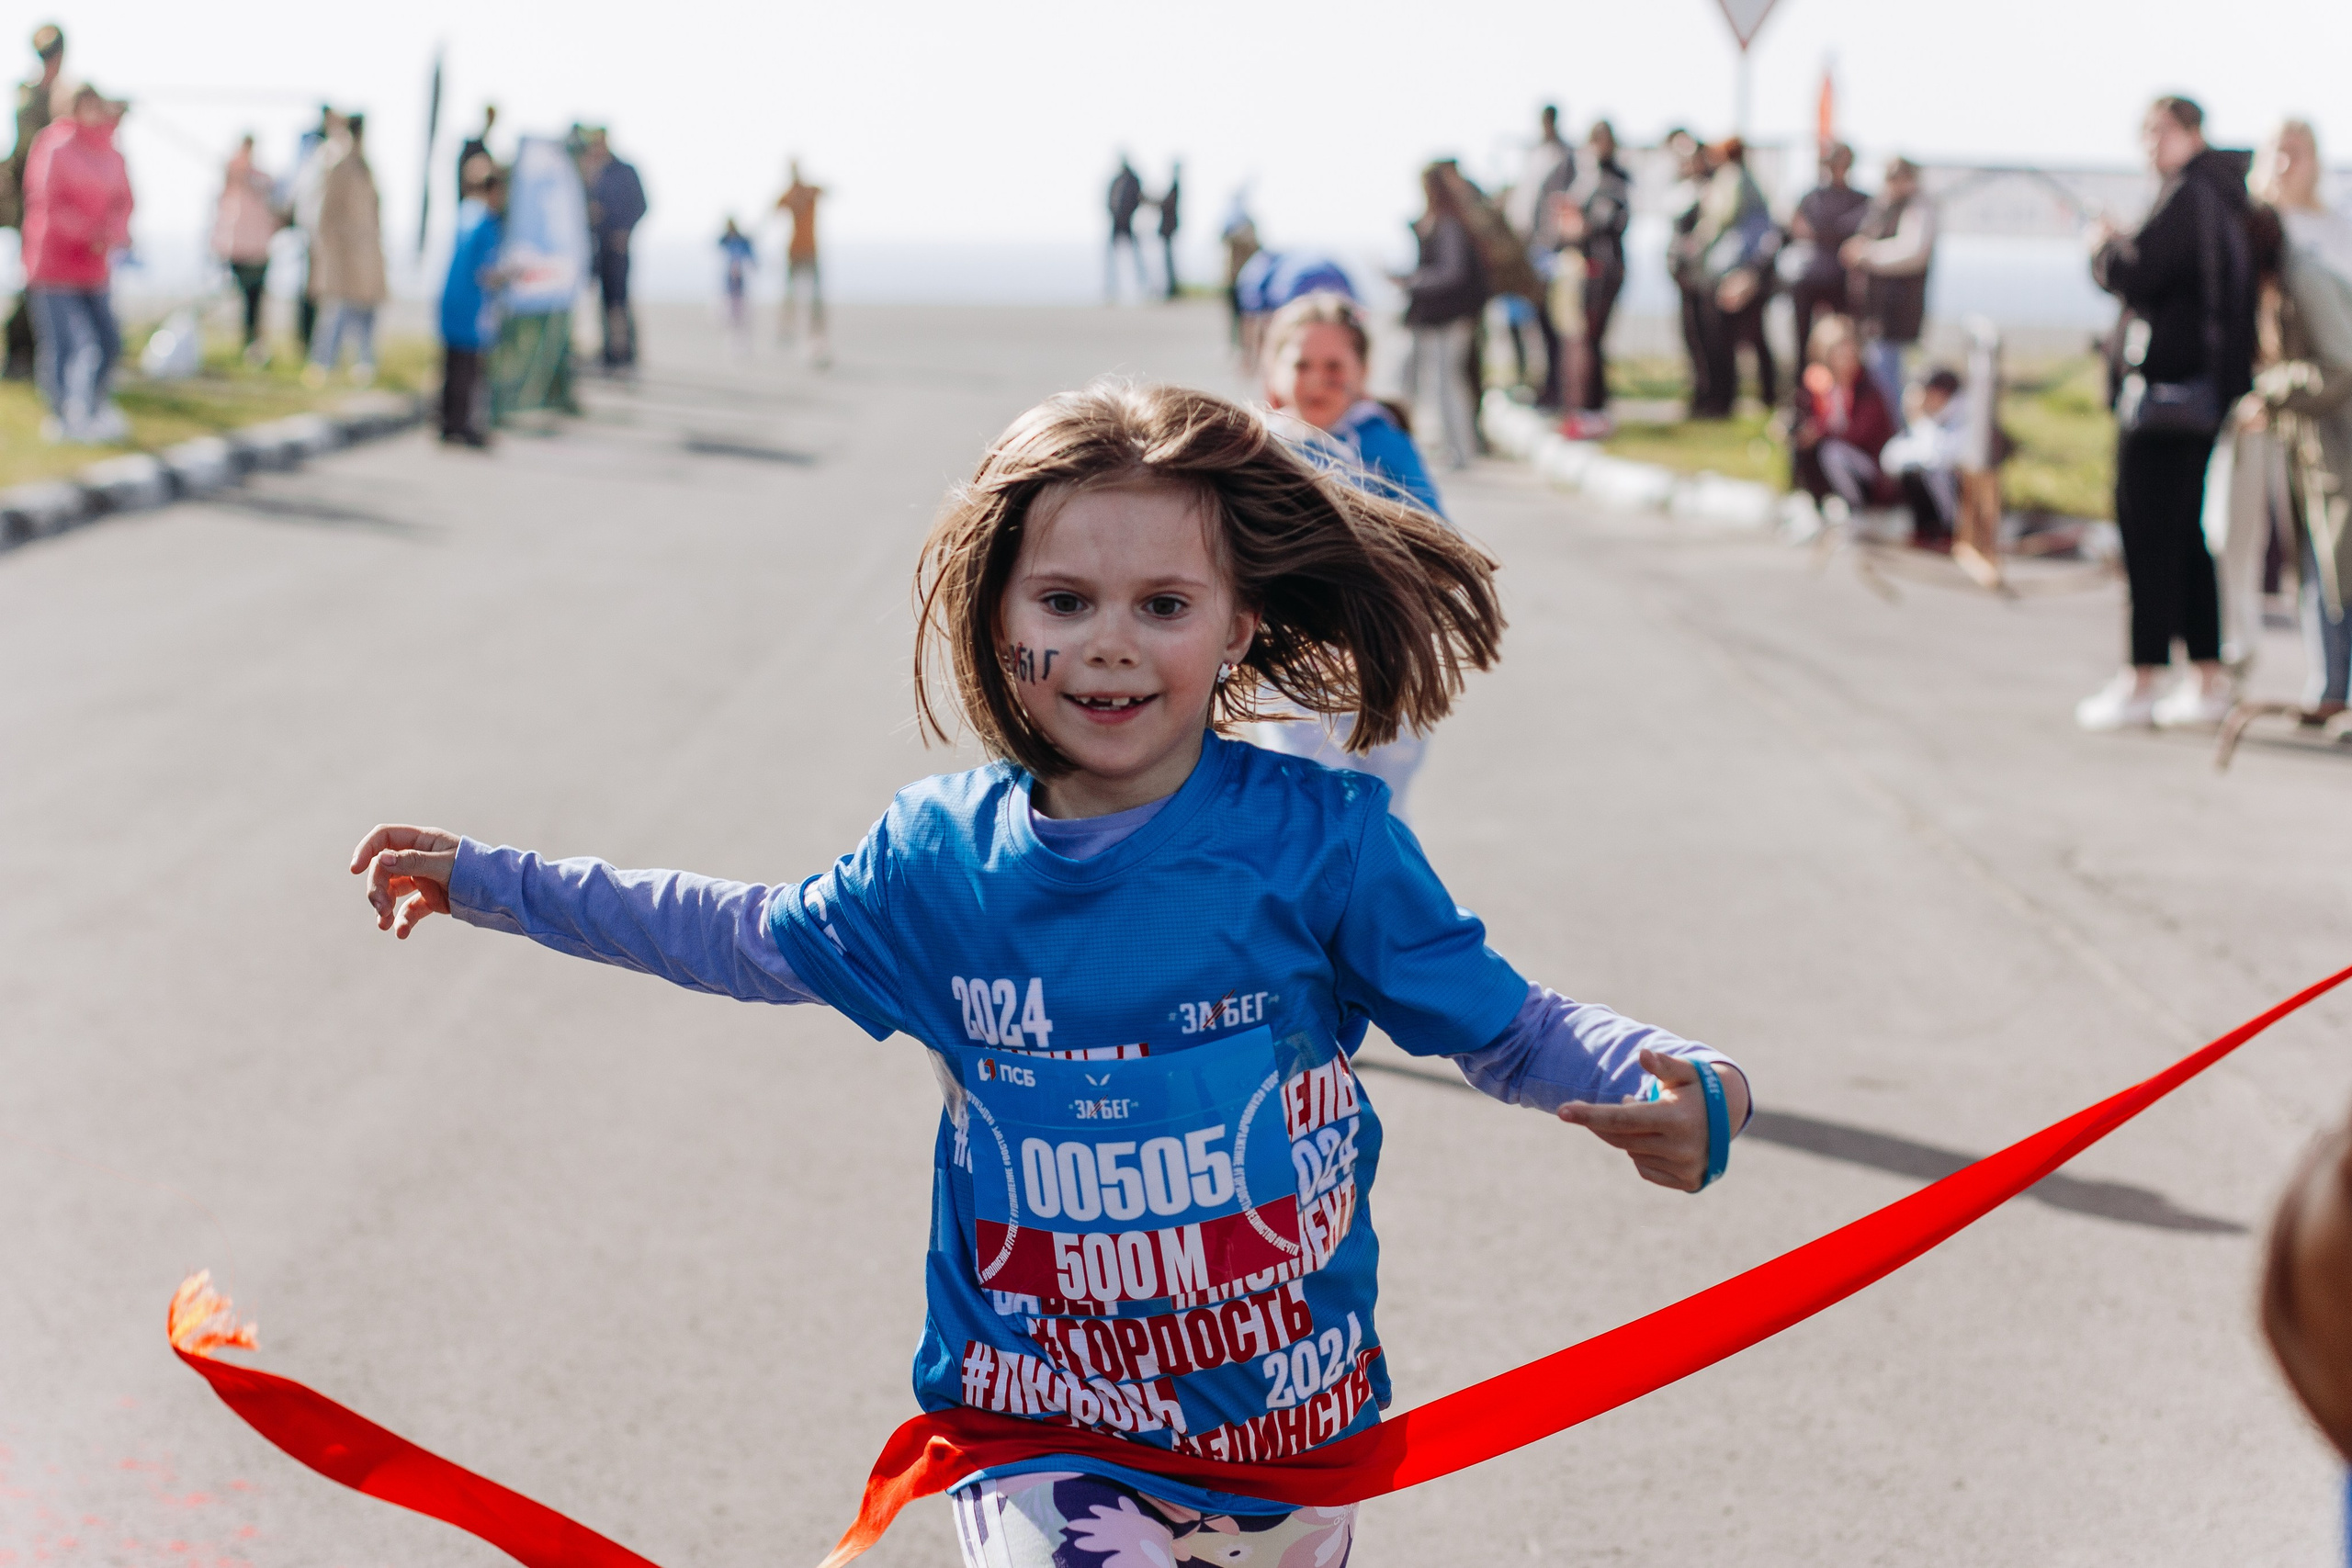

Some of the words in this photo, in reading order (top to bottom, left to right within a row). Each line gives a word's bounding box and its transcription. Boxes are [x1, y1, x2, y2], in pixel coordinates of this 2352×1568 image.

[951, 976, 1053, 1048] 2024
[999, 1063, 1036, 1088] ПСБ
[1022, 1125, 1235, 1222] 00505
[1291, 1115, 1359, 1206] 024
[981, 1246, 1012, 1282] #ВОЛНЕНИЕ
[1004, 1216, 1019, 1251] #ТРЕПЕТ
[1054, 1230, 1159, 1301] 500
[1244, 1208, 1279, 1245] #ЕДИНСТВО
[1272, 1235, 1301, 1258] #МЕЧТА
